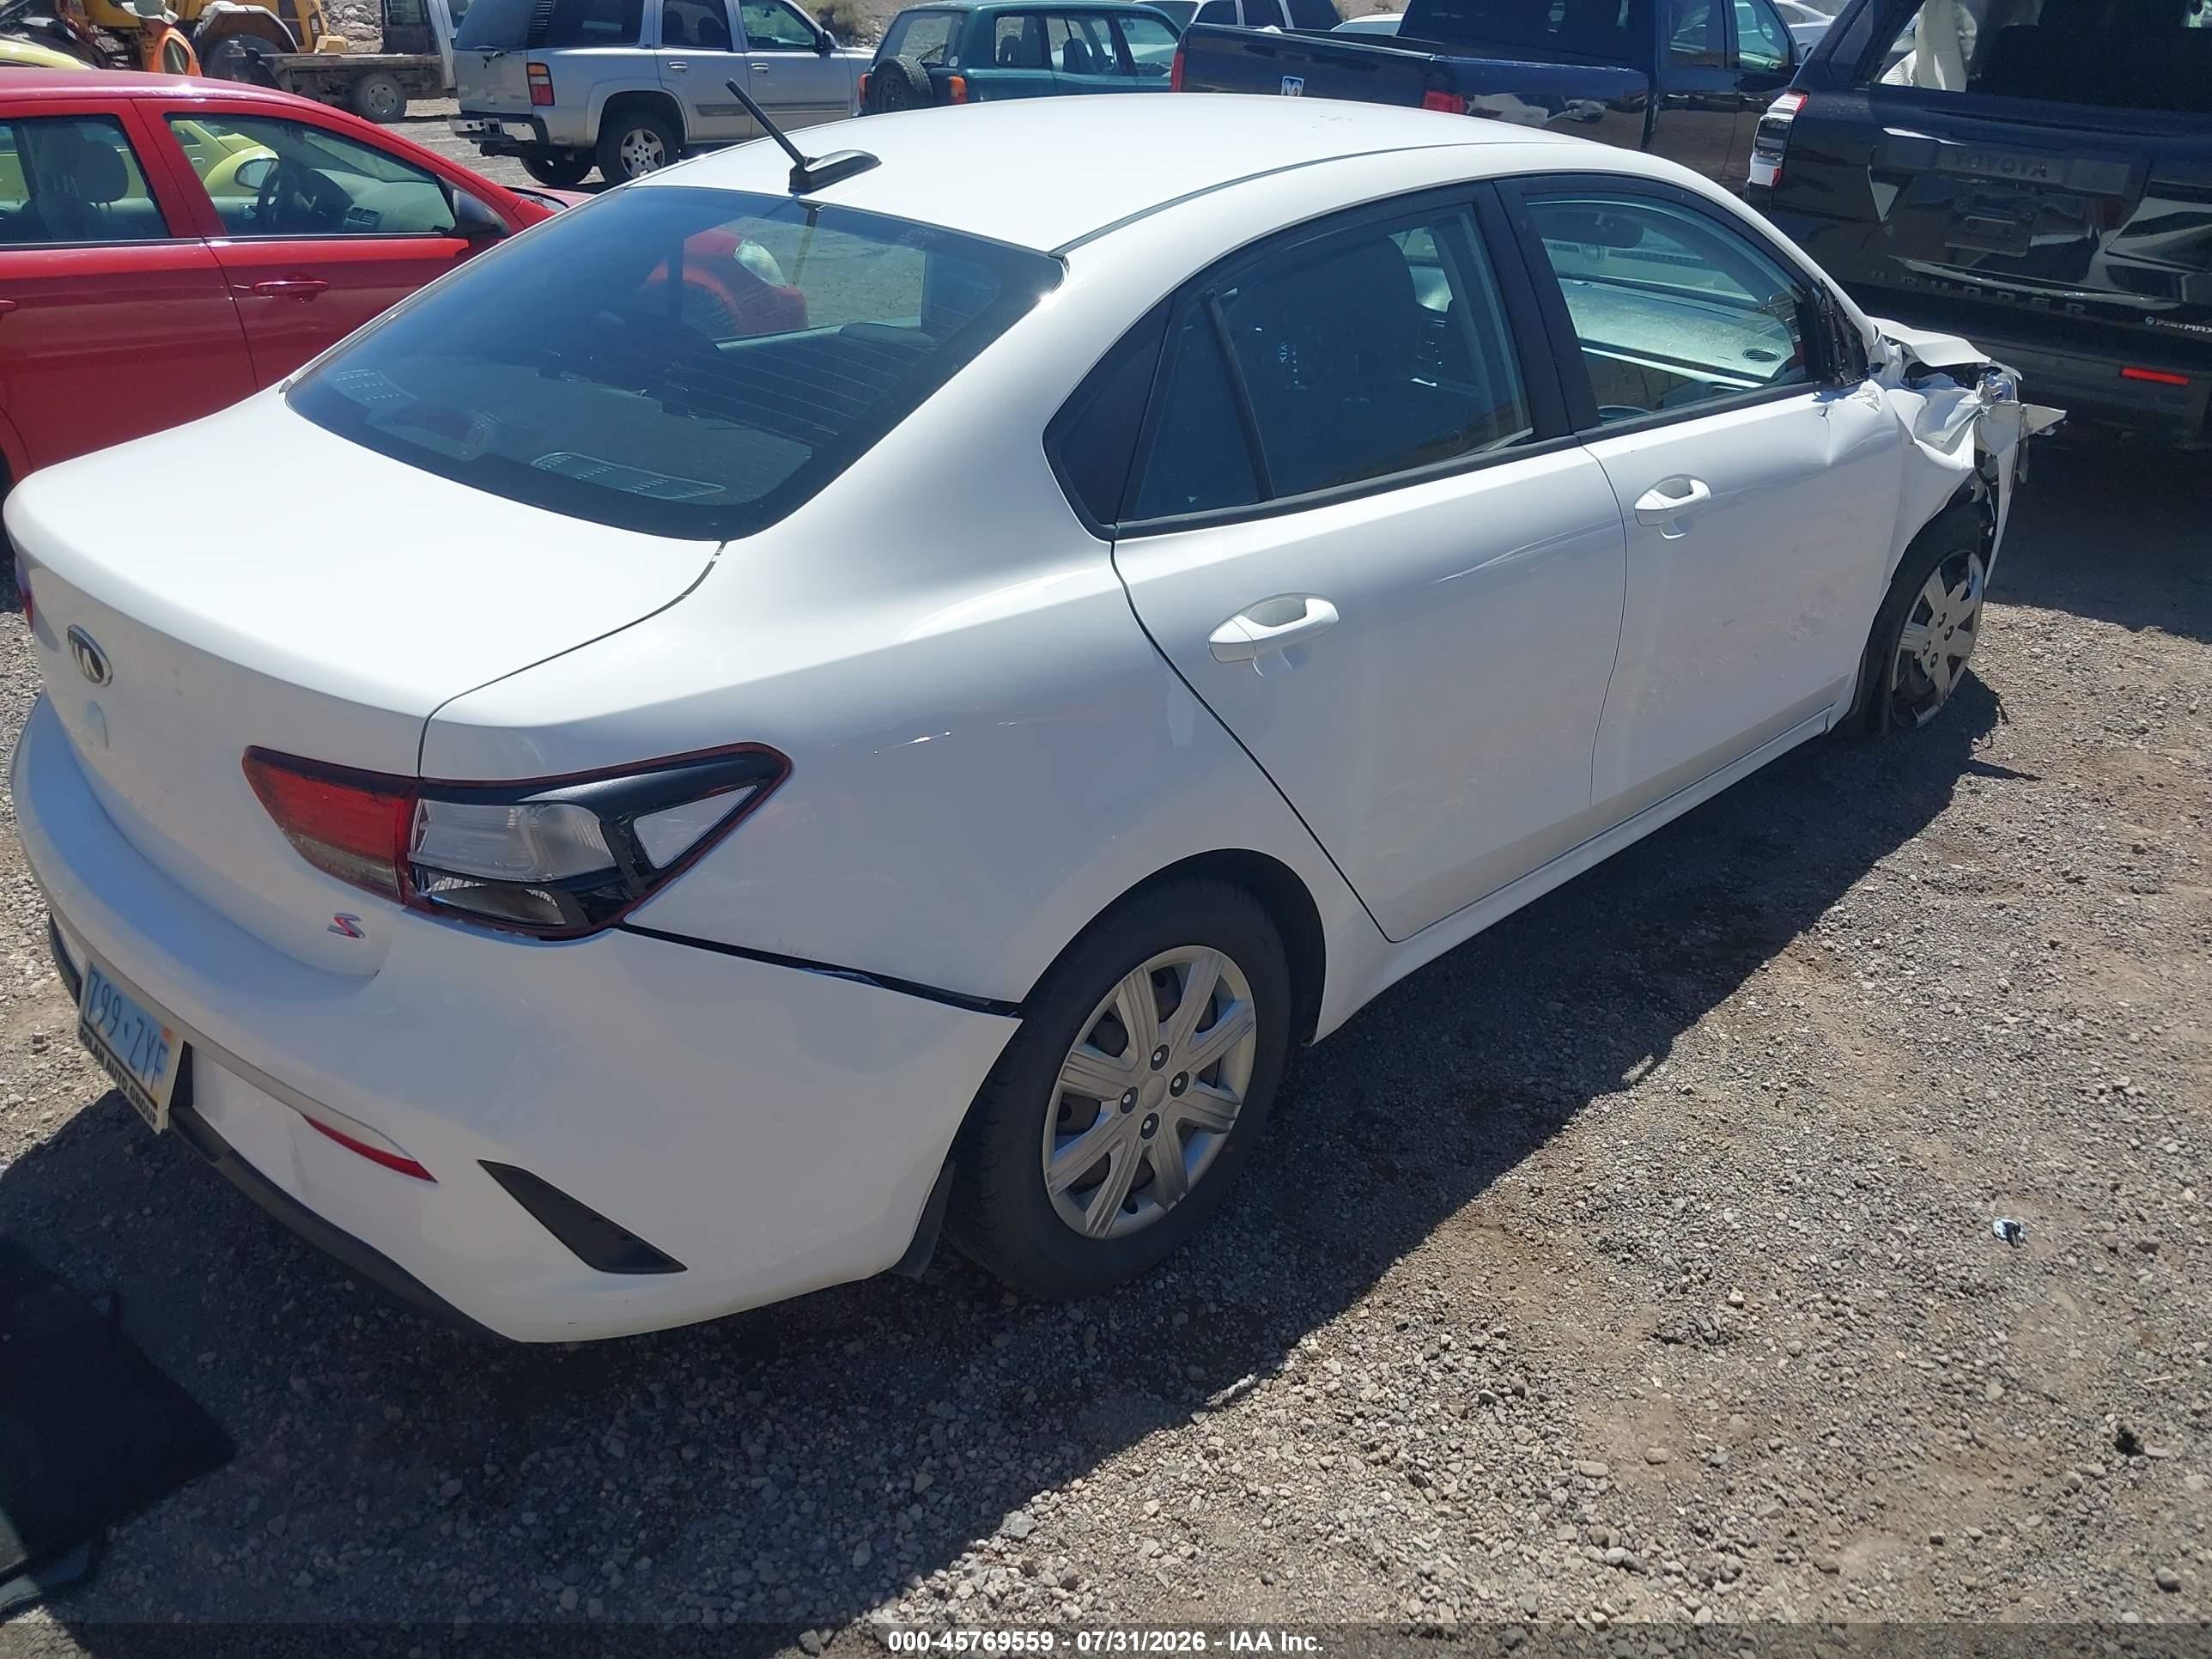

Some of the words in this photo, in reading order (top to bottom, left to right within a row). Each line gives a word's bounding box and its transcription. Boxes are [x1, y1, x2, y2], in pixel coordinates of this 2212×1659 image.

[1953, 152, 2047, 178] TOYOTA
[106, 1060, 128, 1092] AUTO
[130, 1085, 158, 1127] GROUP
